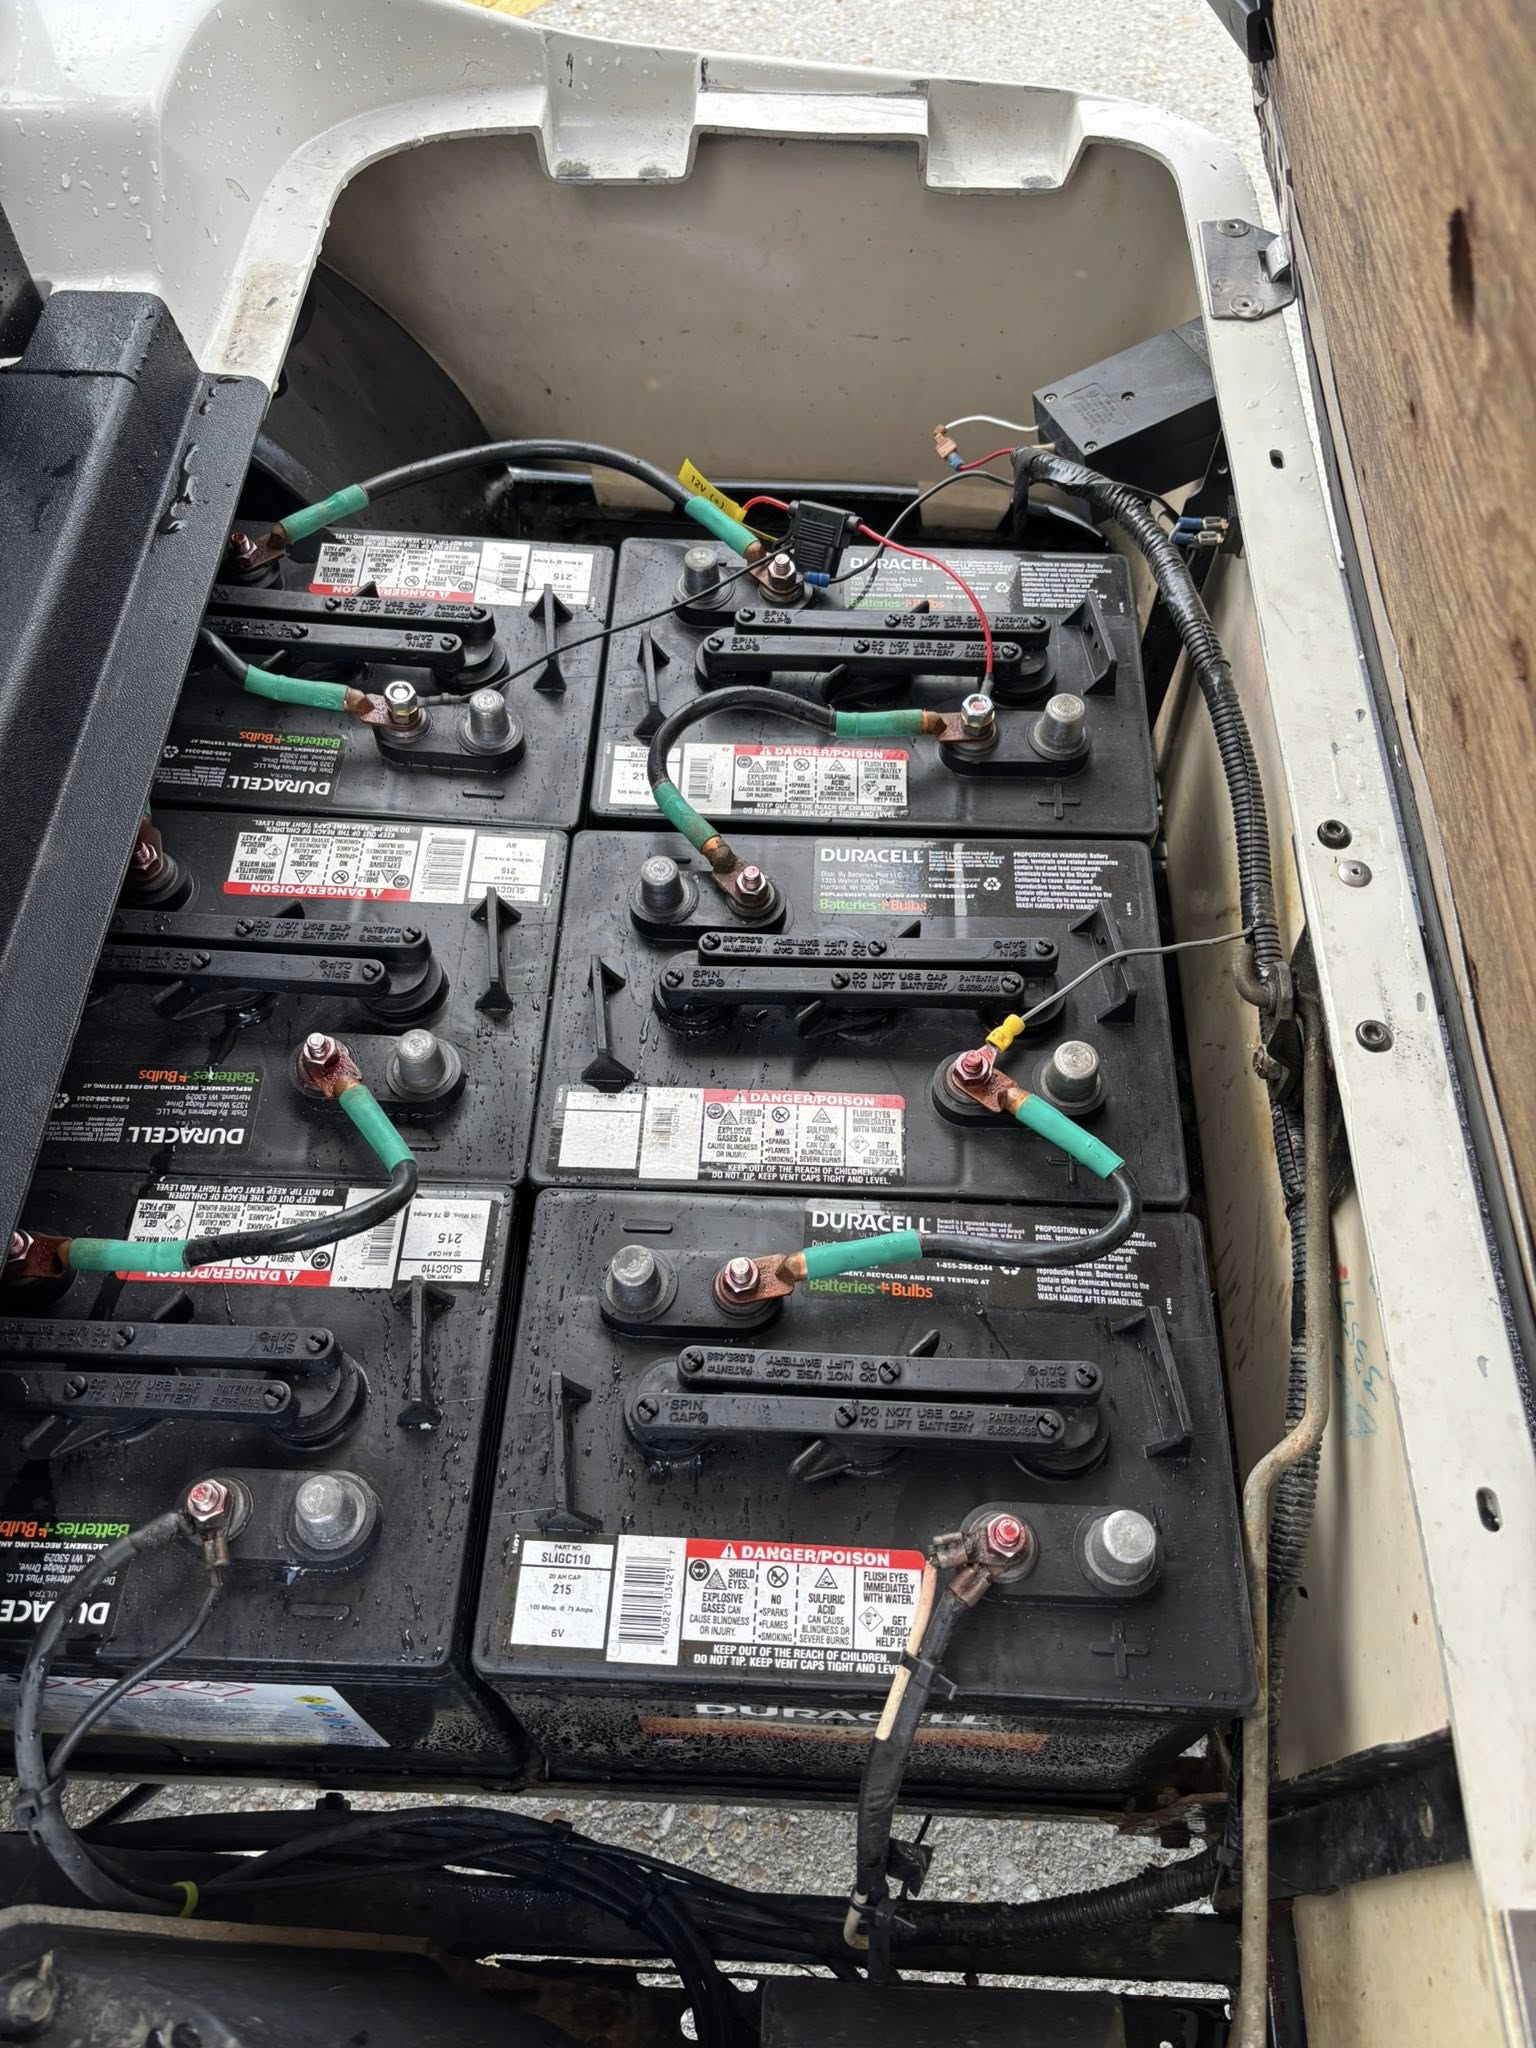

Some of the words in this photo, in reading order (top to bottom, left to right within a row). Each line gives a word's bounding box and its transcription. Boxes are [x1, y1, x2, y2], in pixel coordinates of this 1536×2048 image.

[690, 475, 706, 493] 12V
[553, 573, 573, 581] 215
[776, 747, 884, 759] DANGER/POISON
[229, 775, 331, 795] DURACELL
[820, 848, 922, 864] DURACELL
[501, 867, 516, 875] 215
[251, 884, 368, 899] DANGER/POISON
[693, 970, 720, 979] SPIN
[852, 972, 867, 980] DO
[872, 972, 894, 981] NOT
[899, 973, 920, 981] USE
[926, 974, 948, 982] CAP
[852, 981, 866, 989] TO
[872, 981, 894, 990] LIFT
[900, 982, 948, 991] BATTERY
[183, 1100, 203, 1108] Ridge
[205, 1101, 228, 1109] Walnut
[231, 1101, 248, 1109] 1325
[751, 1092, 874, 1107] DANGER/POISON
[171, 1108, 186, 1116] Plus
[189, 1108, 216, 1116] Batteries
[218, 1109, 227, 1117] By
[230, 1109, 247, 1117] Distr.
[128, 1126, 244, 1145] DURACELL
[725, 1172, 741, 1180] NOT
[780, 1174, 797, 1182] VENT
[801, 1175, 820, 1183] CAPS
[866, 1177, 891, 1185] LEVEL.
[811, 1210, 931, 1235] DURACELL
[438, 1234, 462, 1245] 215
[422, 1264, 463, 1274] SLIGC110
[867, 1272, 908, 1281] RECYCLING
[912, 1274, 925, 1282] AND
[927, 1275, 945, 1283] FREE
[948, 1276, 981, 1285] TESTING
[1038, 1294, 1057, 1303] WASH
[1060, 1295, 1081, 1304] HANDS
[1084, 1296, 1106, 1306] AFTER
[1108, 1297, 1144, 1308] HANDLING.
[671, 1399, 704, 1411] SPIN
[861, 1405, 879, 1417] DO
[885, 1406, 911, 1419] NOT
[917, 1408, 943, 1420] USE
[948, 1410, 975, 1422] CAP
[861, 1417, 878, 1429] TO
[884, 1418, 910, 1430] LIFT
[918, 1420, 975, 1433] BATTERY
[43, 1553, 69, 1562] 53029
[73, 1553, 83, 1562] WI
[541, 1552, 591, 1565] SLIGC110
[741, 1545, 890, 1567] DANGER/POISON
[43, 1563, 66, 1571] Ridge
[26, 1574, 43, 1583] Plus
[728, 1569, 755, 1579] SHIELD
[864, 1571, 886, 1582] FLUSH
[889, 1572, 908, 1583] EYES
[552, 1583, 572, 1595] 215
[728, 1579, 750, 1590] EYES.
[864, 1581, 915, 1594] IMMEDIATELY
[702, 1591, 744, 1604] EXPLOSIVE
[771, 1594, 782, 1605] NO
[808, 1592, 845, 1605] SULFURIC
[864, 1592, 884, 1603] WITH
[886, 1593, 915, 1604] WATER.
[701, 1602, 726, 1614] GASES
[728, 1604, 742, 1615] CAN
[817, 1604, 835, 1615] ACID
[690, 1614, 711, 1624] CAUSE
[712, 1615, 749, 1626] BLINDNESS
[808, 1614, 822, 1624] CAN
[824, 1615, 845, 1626] CAUSE
[892, 1616, 907, 1626] GET
[551, 1629, 565, 1638] 6V
[700, 1626, 708, 1635] OR
[710, 1627, 737, 1637] INJURY.
[801, 1624, 838, 1636] BLINDNESS
[840, 1626, 851, 1636] OR
[800, 1634, 824, 1644] SEVERE
[876, 1637, 895, 1647] HELP
[713, 1644, 734, 1655] KEEP
[737, 1645, 756, 1656] OUT
[759, 1646, 770, 1657] OF
[773, 1647, 791, 1658] THE
[795, 1648, 824, 1660] REACH
[827, 1650, 838, 1661] OF
[841, 1651, 890, 1664] CHILDREN.
[694, 1654, 706, 1665] DO
[709, 1655, 728, 1666] NOT
[731, 1656, 747, 1667] TIP.
[750, 1657, 772, 1668] KEEP
[775, 1658, 798, 1670] VENT
[801, 1659, 824, 1671] CAPS
[827, 1661, 855, 1673] TIGHT
[856, 1662, 876, 1674] AND
[696, 1702, 988, 1726] DURACLL
